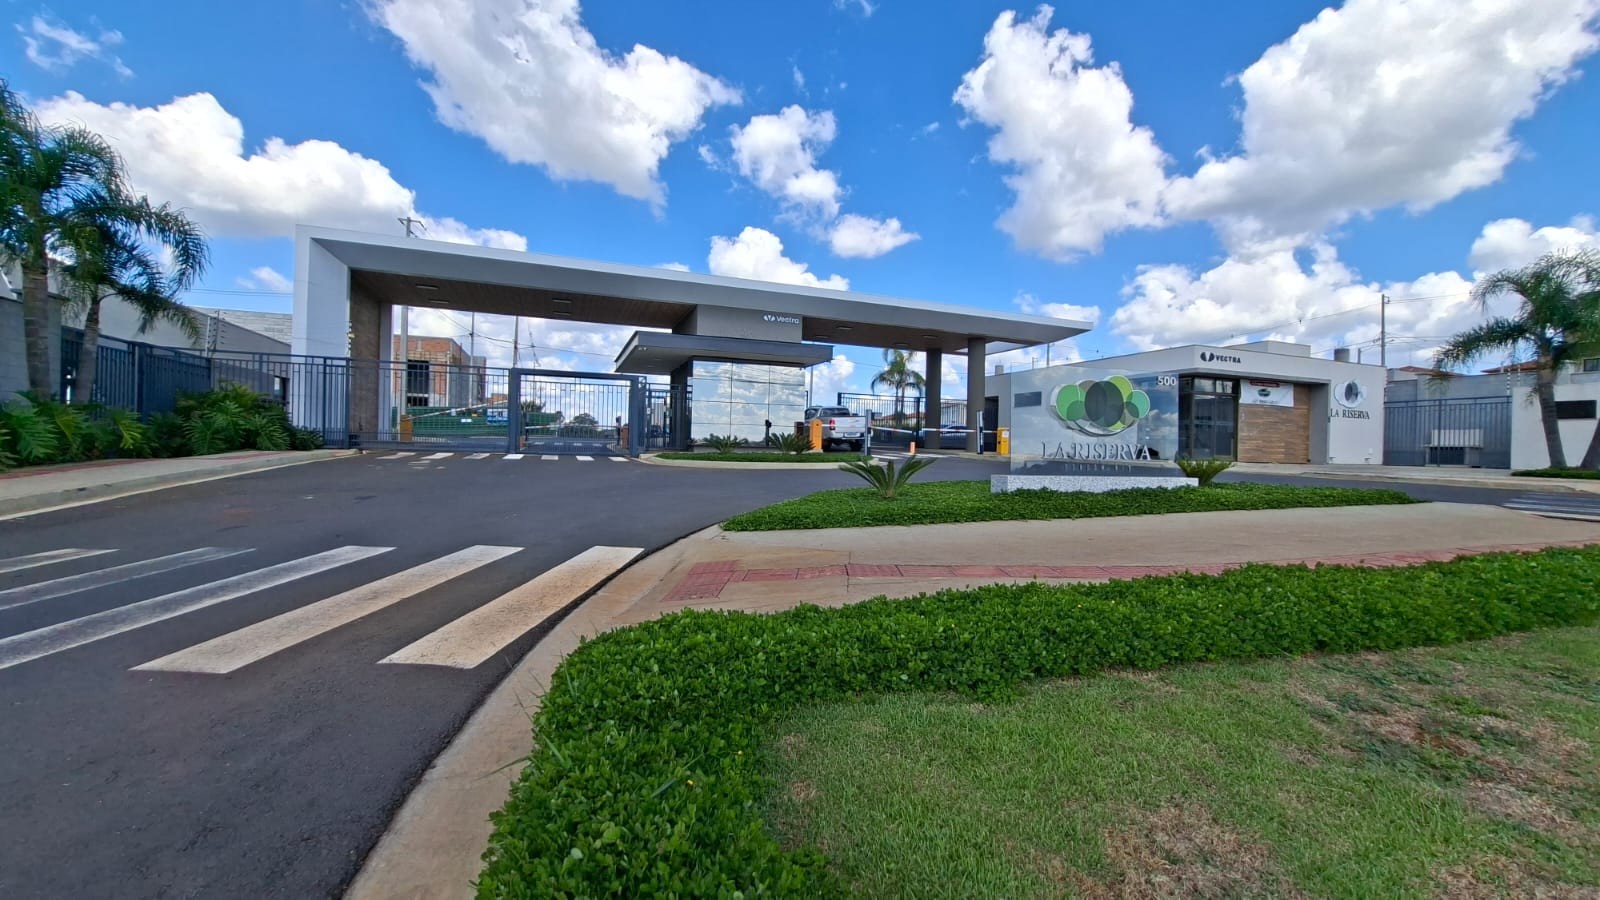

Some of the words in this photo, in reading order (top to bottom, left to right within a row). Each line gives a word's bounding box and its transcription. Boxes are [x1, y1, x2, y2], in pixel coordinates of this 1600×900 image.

[776, 315, 800, 324] Vectra
[1215, 354, 1242, 364] VECTRA
[1157, 375, 1177, 386] 500
[1330, 408, 1340, 418] LA
[1342, 409, 1370, 420] RISERVA
[1041, 441, 1068, 460] LA
[1071, 442, 1152, 461] RISERVA
